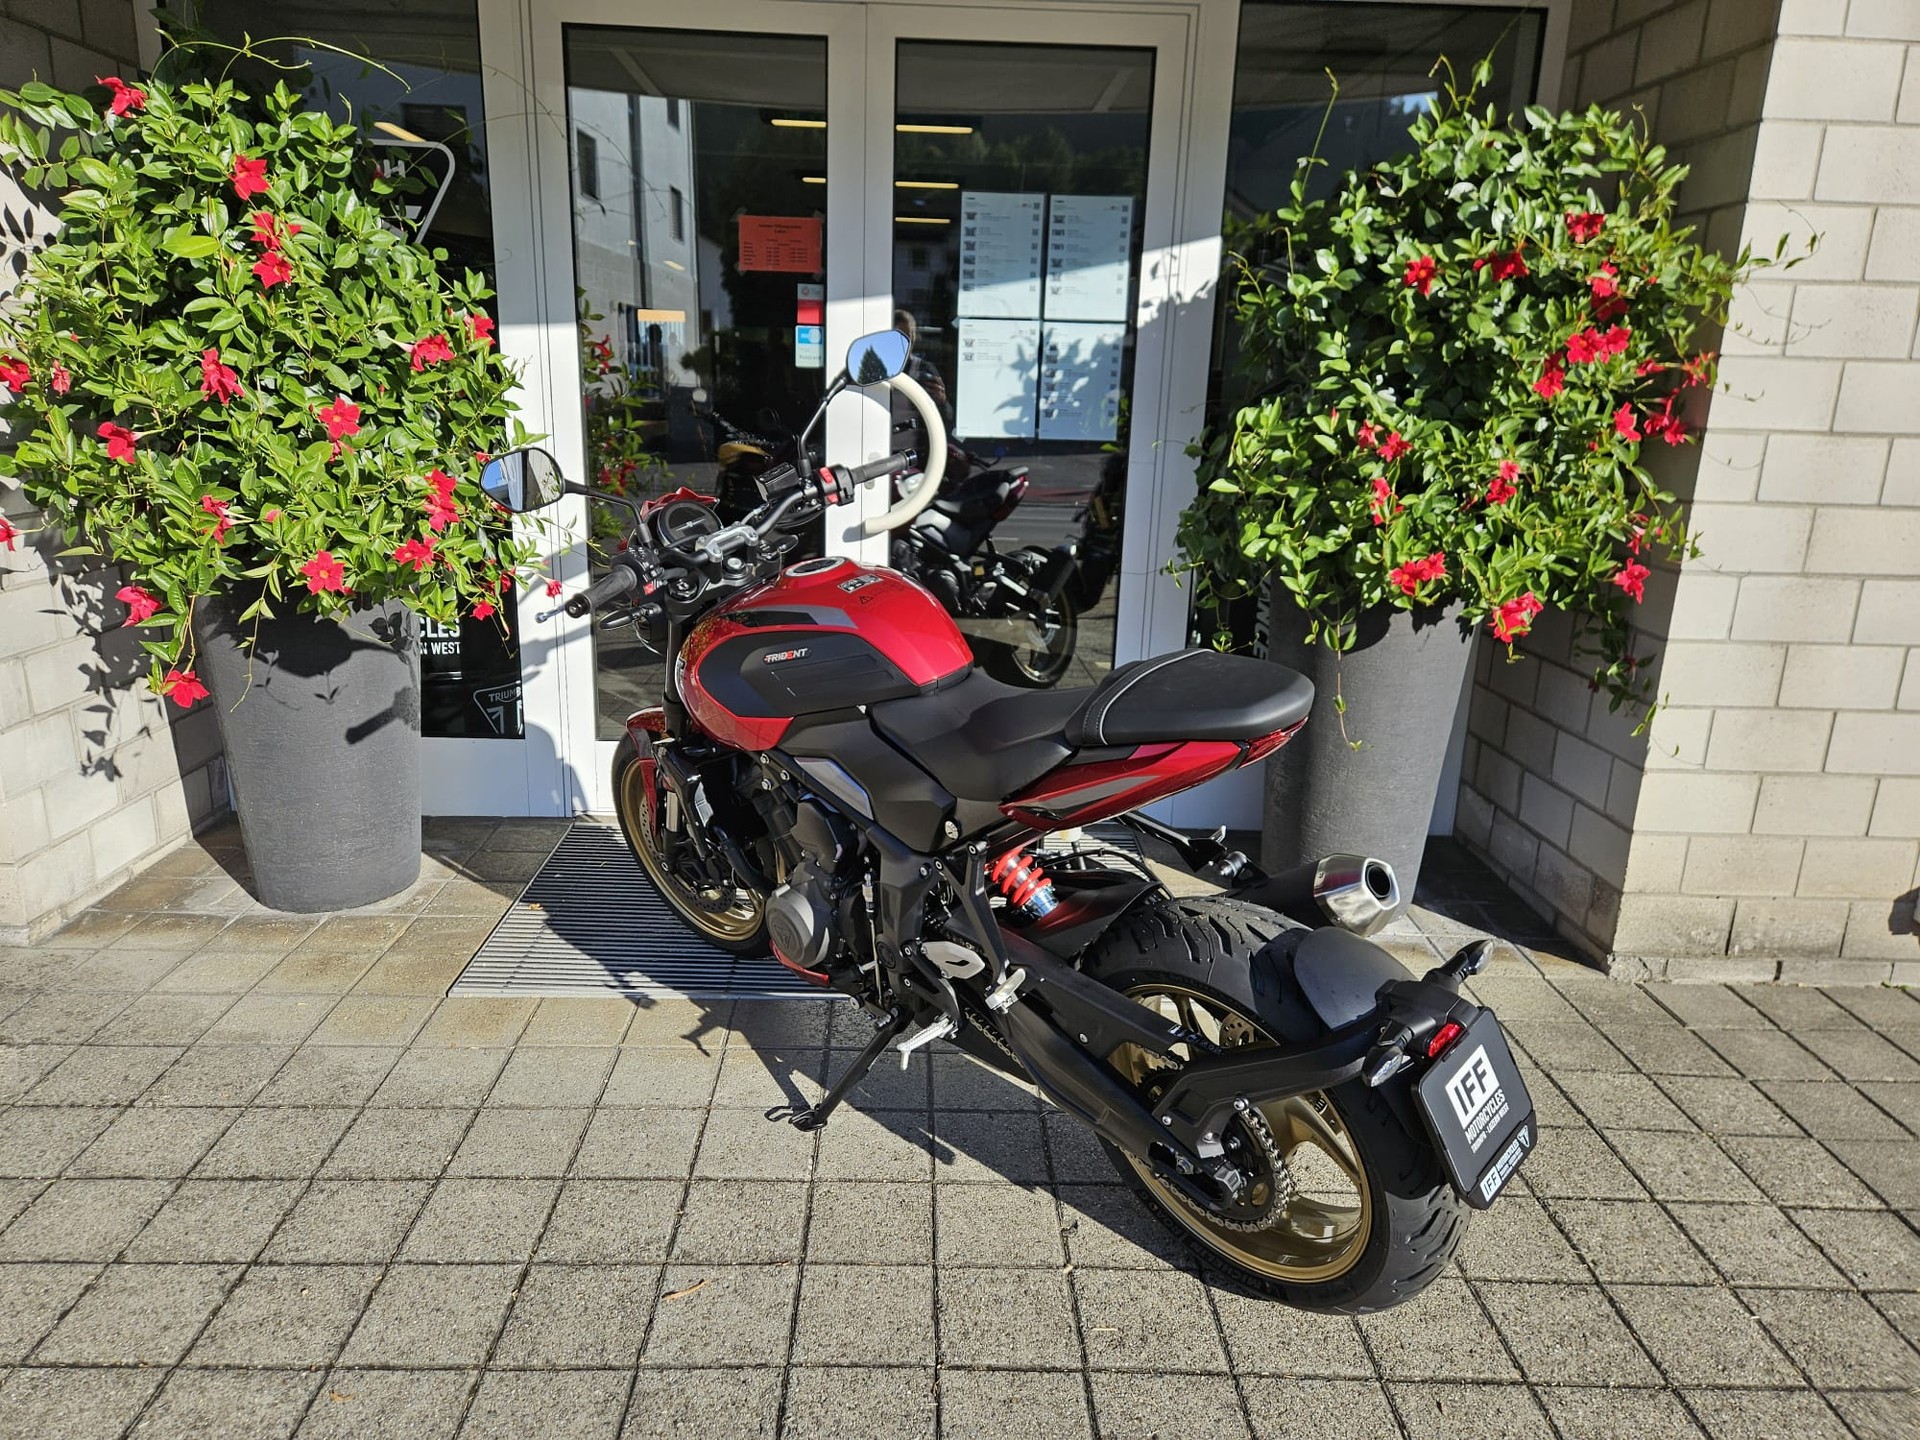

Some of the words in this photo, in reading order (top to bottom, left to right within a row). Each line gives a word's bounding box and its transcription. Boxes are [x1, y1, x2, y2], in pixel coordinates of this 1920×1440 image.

[431, 642, 461, 655] WEST
[764, 647, 808, 663] TRIDENT
[1453, 1057, 1488, 1116] IFF
[1464, 1087, 1506, 1145] MOTORCYCLES
[1483, 1170, 1498, 1197] IFF
